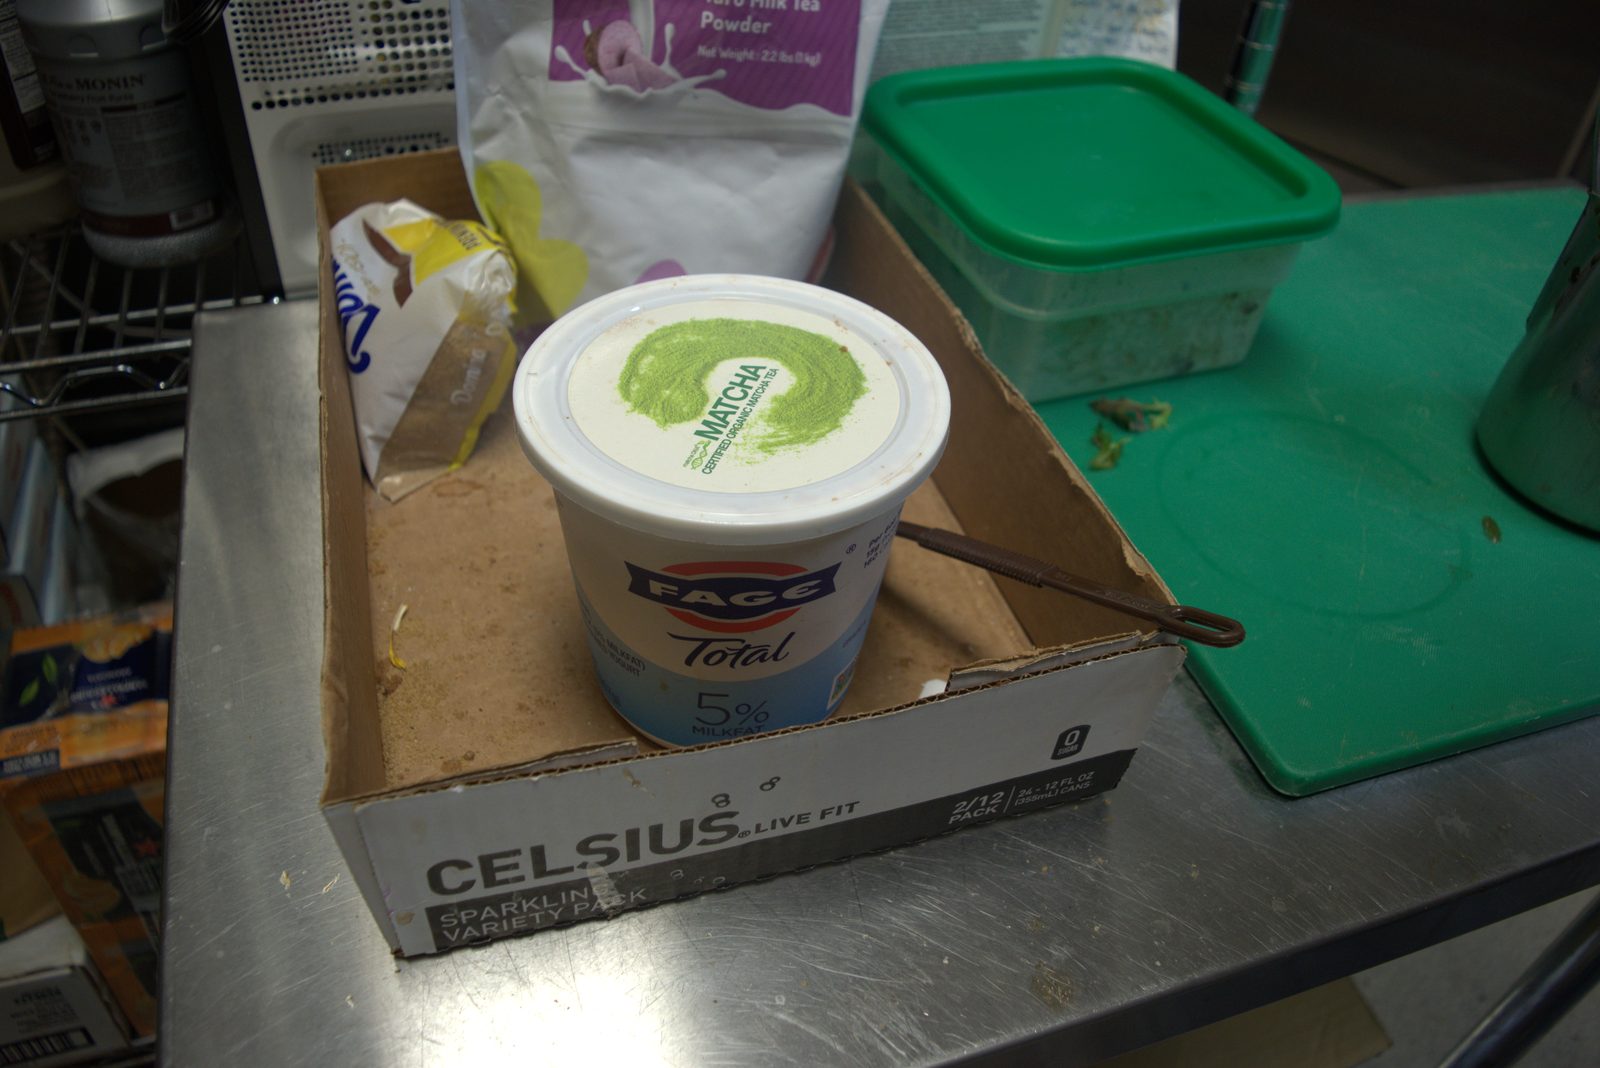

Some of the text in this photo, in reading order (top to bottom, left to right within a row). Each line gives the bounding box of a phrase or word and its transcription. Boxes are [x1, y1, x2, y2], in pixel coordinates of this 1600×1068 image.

[793, 0, 821, 11] Tea
[700, 10, 772, 34] Powder
[698, 45, 717, 58] Net
[75, 74, 145, 91] MONIN
[694, 365, 767, 441] MATCHA
[702, 368, 780, 475] CERTIFIED ORGANIC MATCHA TEA
[649, 579, 823, 607] FAGE
[666, 631, 796, 669] Total
[695, 692, 770, 726] 5%
[692, 725, 766, 737] MILKFAT
[1064, 729, 1081, 746] 0
[1057, 744, 1079, 756] SUGAR
[1045, 780, 1059, 791] 12
[1060, 775, 1075, 787] FL
[1077, 771, 1096, 782] OZ
[1061, 781, 1091, 794] CANS
[949, 804, 998, 824] PACK
[952, 791, 1005, 815] 2/12
[427, 801, 861, 896] CELSIUS LIVE FIT
[443, 888, 647, 943] VARIETY PACK
